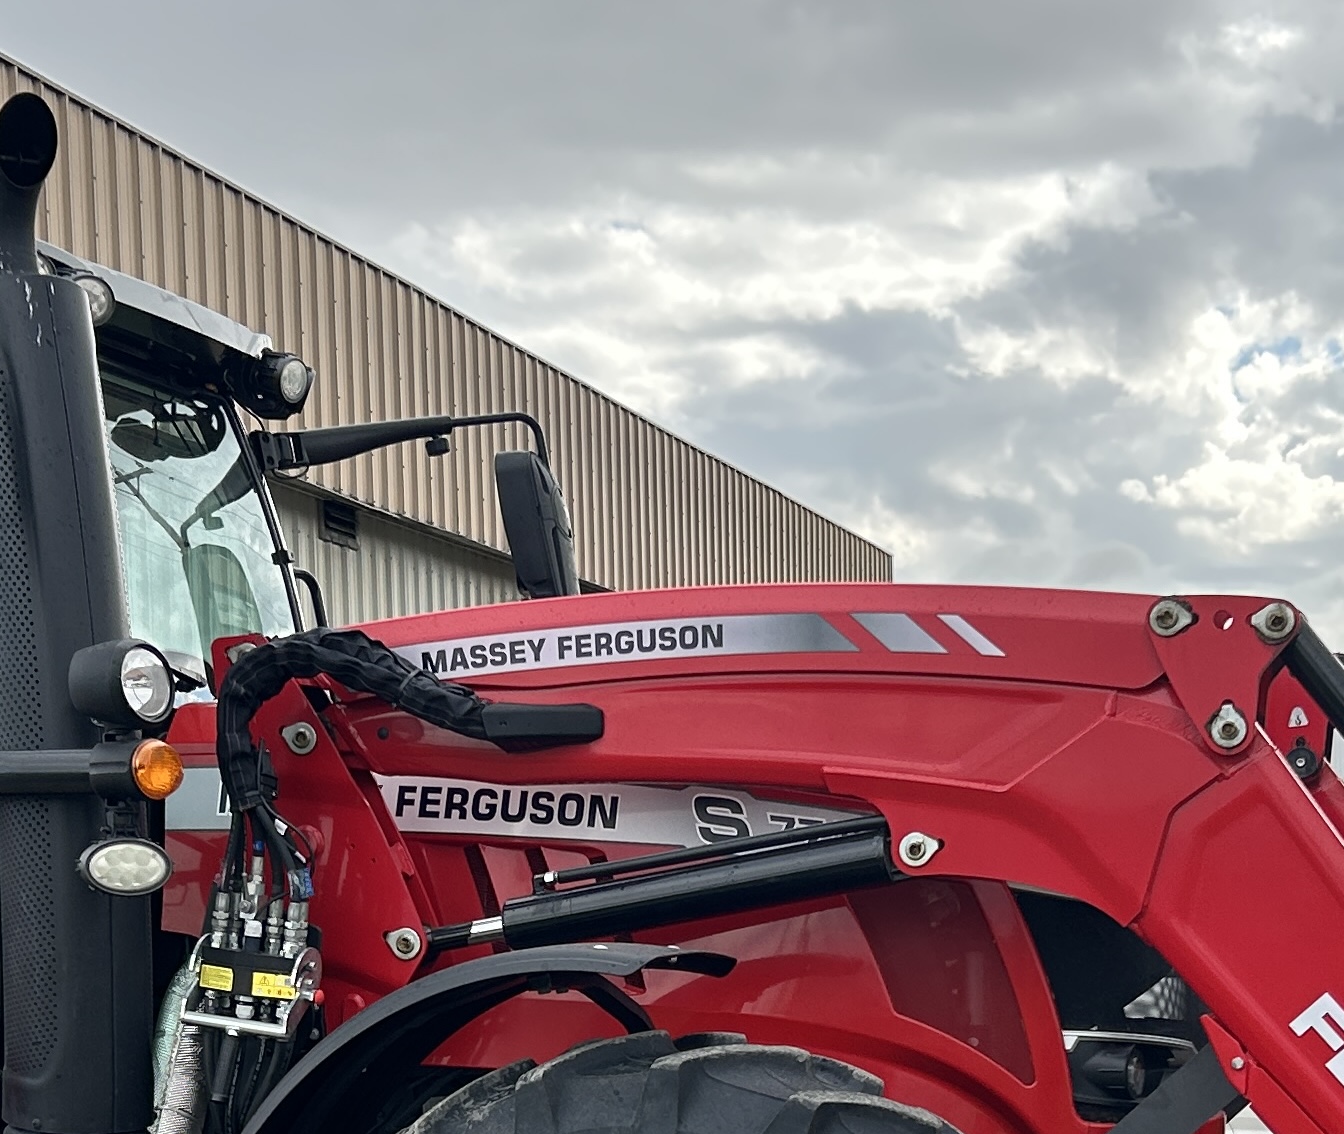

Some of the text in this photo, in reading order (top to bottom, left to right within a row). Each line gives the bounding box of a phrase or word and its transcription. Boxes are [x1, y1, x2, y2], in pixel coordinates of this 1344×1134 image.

[421, 624, 724, 674] MASSEY FERGUSON
[395, 785, 619, 830] FERGUSON
[693, 793, 754, 844] S
